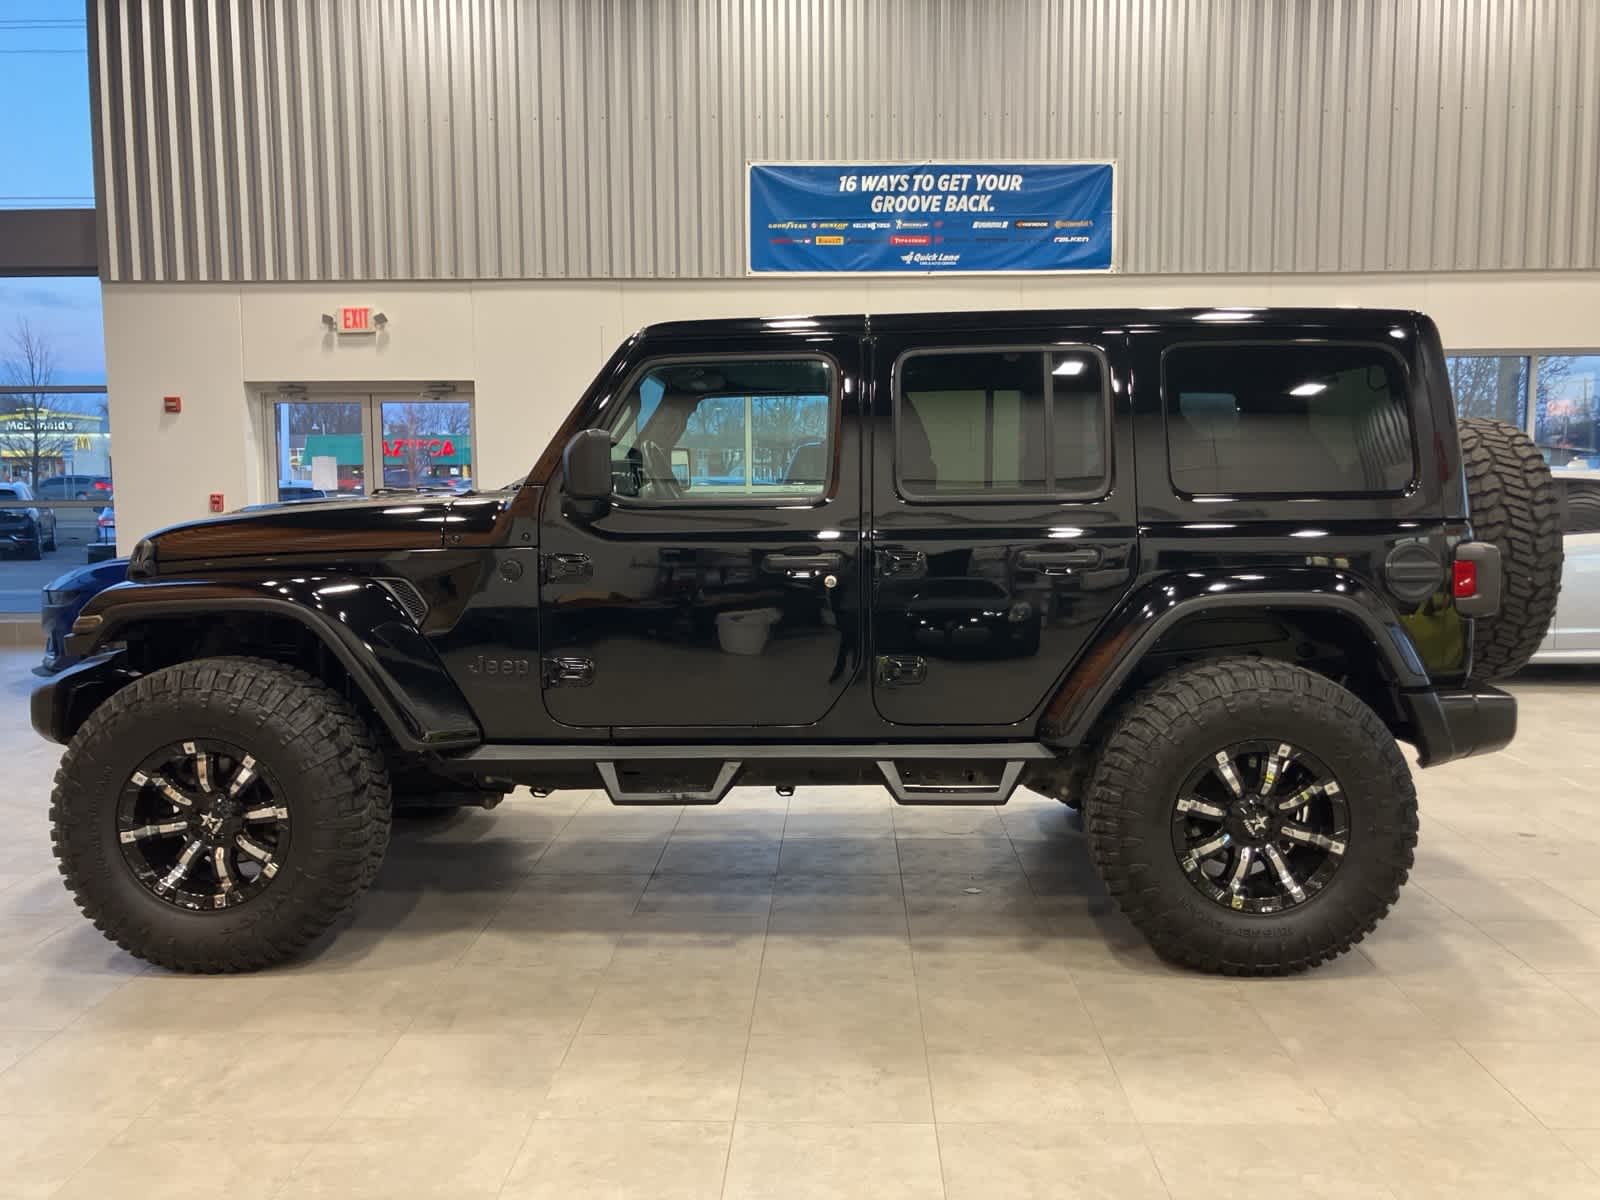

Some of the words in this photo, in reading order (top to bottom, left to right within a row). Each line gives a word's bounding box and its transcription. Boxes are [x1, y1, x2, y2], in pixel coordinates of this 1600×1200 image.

[839, 175, 857, 192] 16
[861, 175, 909, 192] WAYS
[912, 175, 935, 191] TO
[937, 175, 972, 191] GET
[976, 174, 1023, 191] YOUR
[871, 195, 942, 213] GROOVE
[944, 194, 995, 213] BACK.
[913, 253, 938, 263] Quick
[343, 307, 369, 329] EXIT
[467, 655, 529, 677] Jeep
